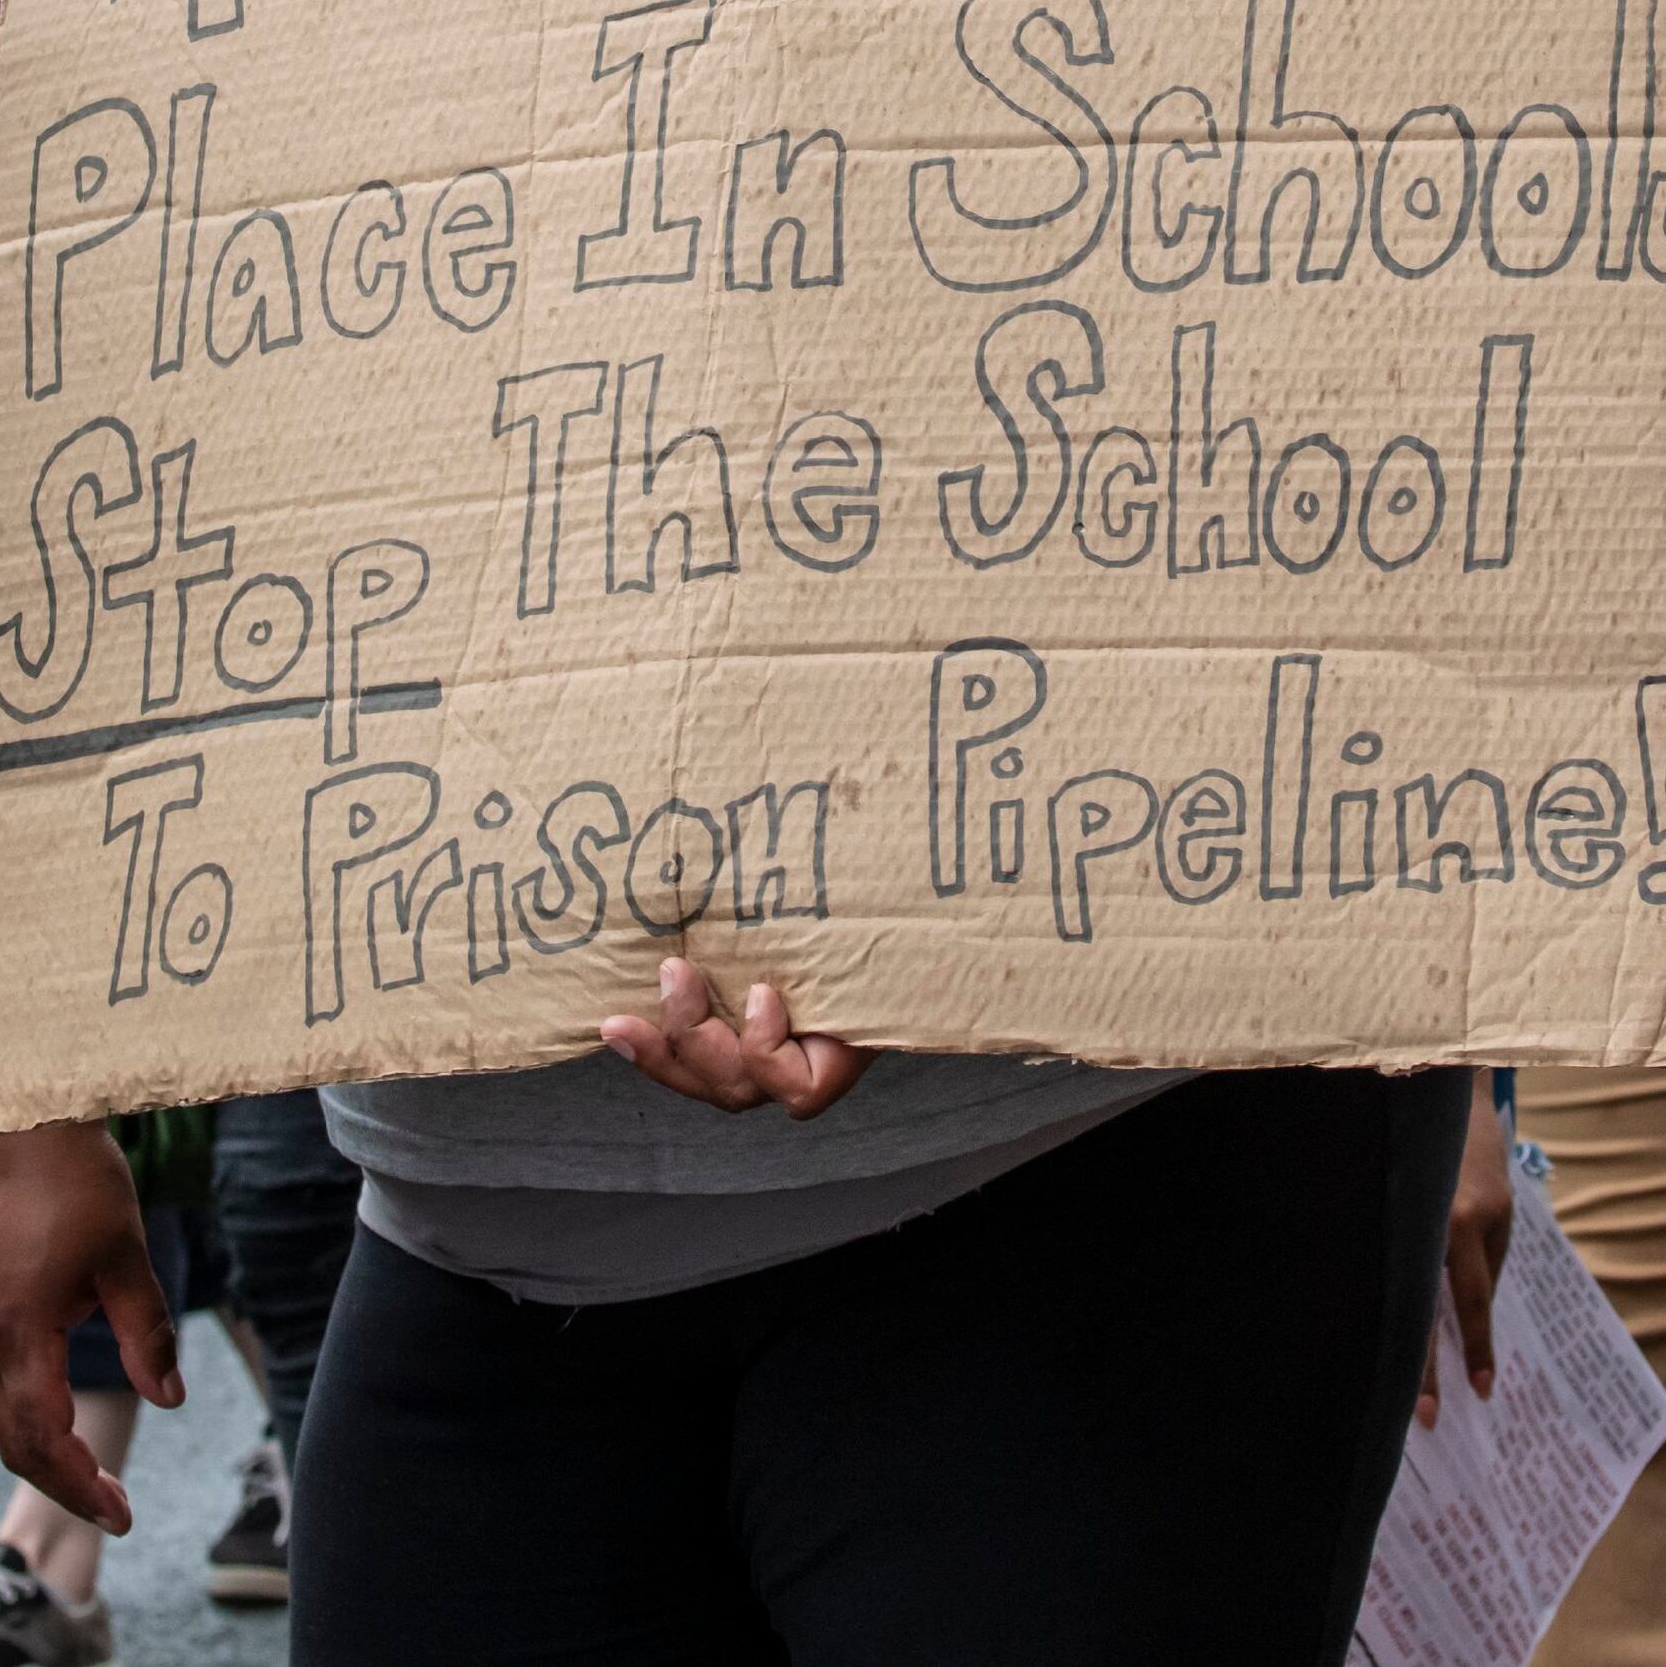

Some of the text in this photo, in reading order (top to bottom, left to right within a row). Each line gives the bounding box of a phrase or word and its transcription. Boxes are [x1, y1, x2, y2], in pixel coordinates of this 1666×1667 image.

[24, 83, 517, 400] Place
[492, 353, 882, 619] The
[937, 300, 1533, 580] School
[103, 752, 233, 1005] To
[302, 761, 832, 1028] Prison
